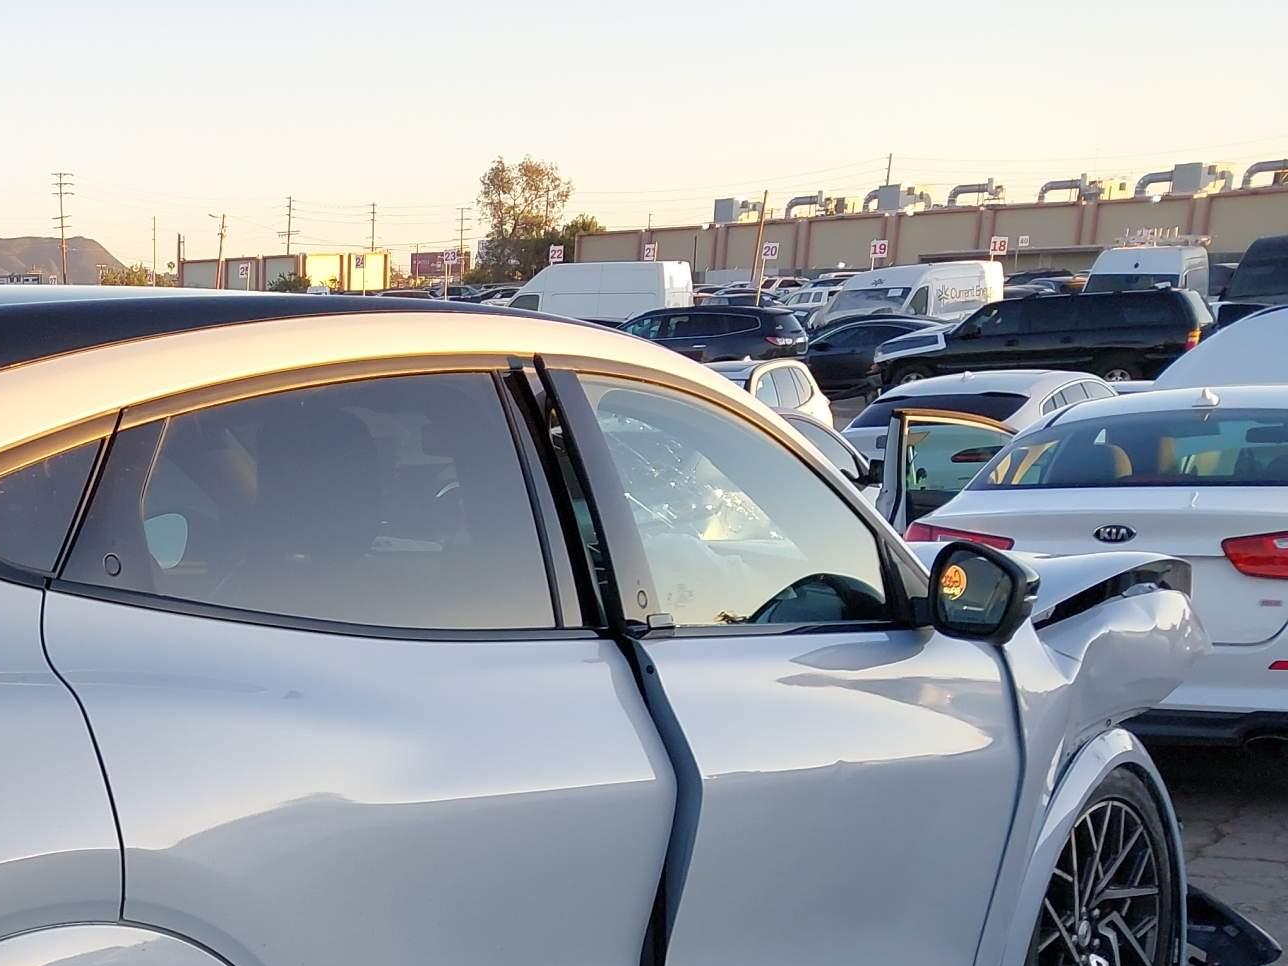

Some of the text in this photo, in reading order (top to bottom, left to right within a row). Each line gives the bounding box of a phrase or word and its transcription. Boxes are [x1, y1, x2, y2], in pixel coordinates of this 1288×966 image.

[763, 245, 778, 257] 20
[871, 243, 886, 255] 19
[991, 240, 1007, 251] 18
[444, 251, 456, 261] 23
[550, 249, 563, 259] 22
[1099, 527, 1128, 540] KIA
